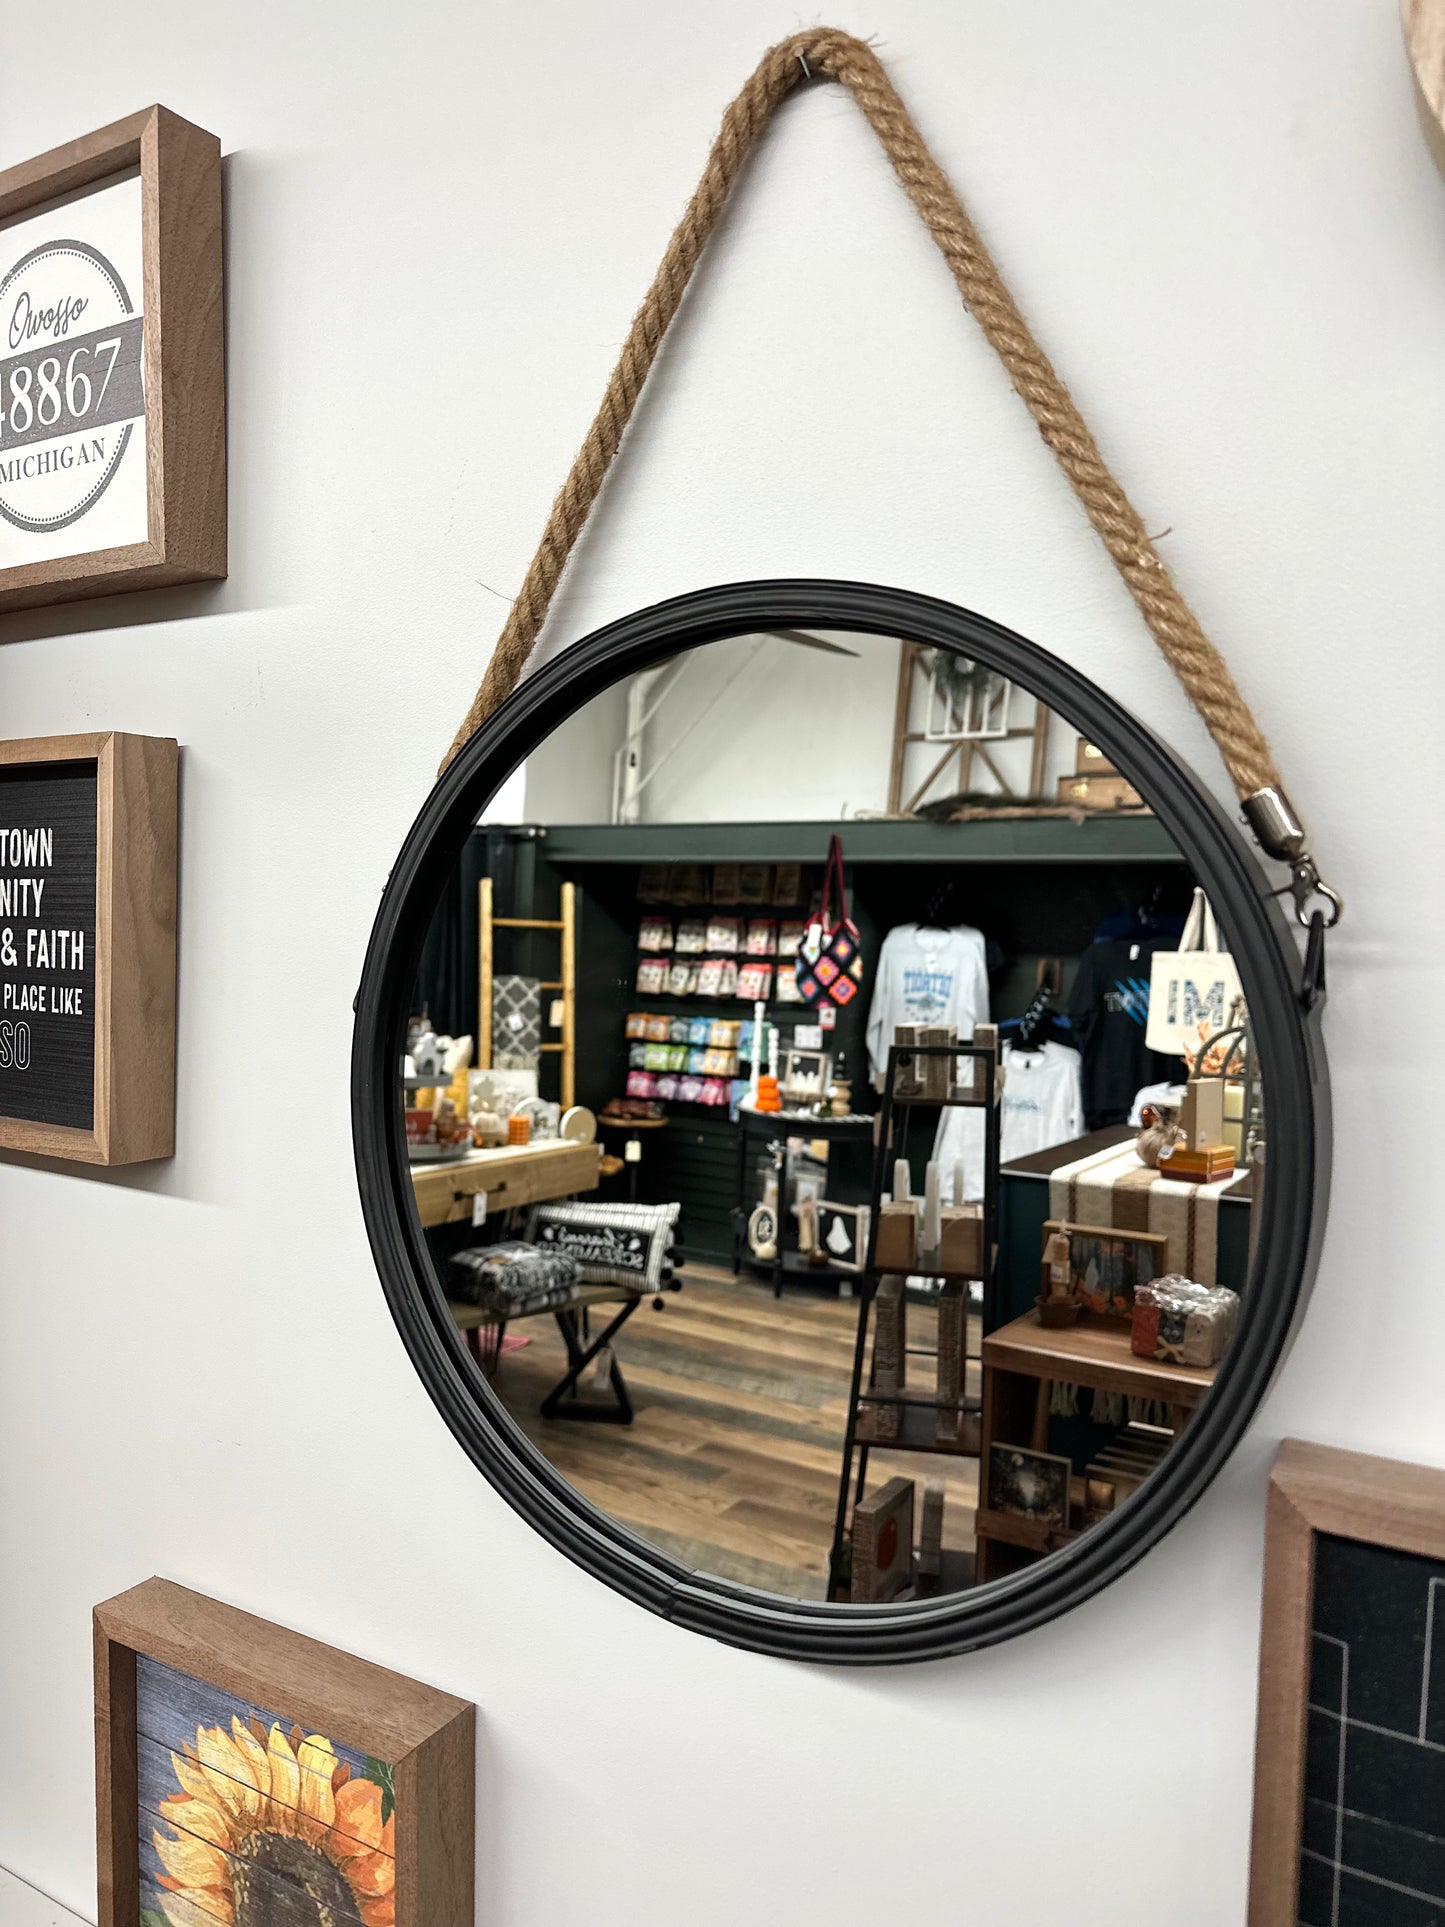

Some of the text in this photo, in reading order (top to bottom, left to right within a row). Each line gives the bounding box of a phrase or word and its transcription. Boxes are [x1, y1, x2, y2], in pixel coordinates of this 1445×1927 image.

[9, 292, 89, 349] Owosso
[0, 337, 122, 436] 8867
[0, 438, 105, 484] MICHIGAN
[0, 828, 53, 867] TOWN
[1, 927, 84, 971] & FAITH
[4, 984, 83, 1015] PLACE LIKE
